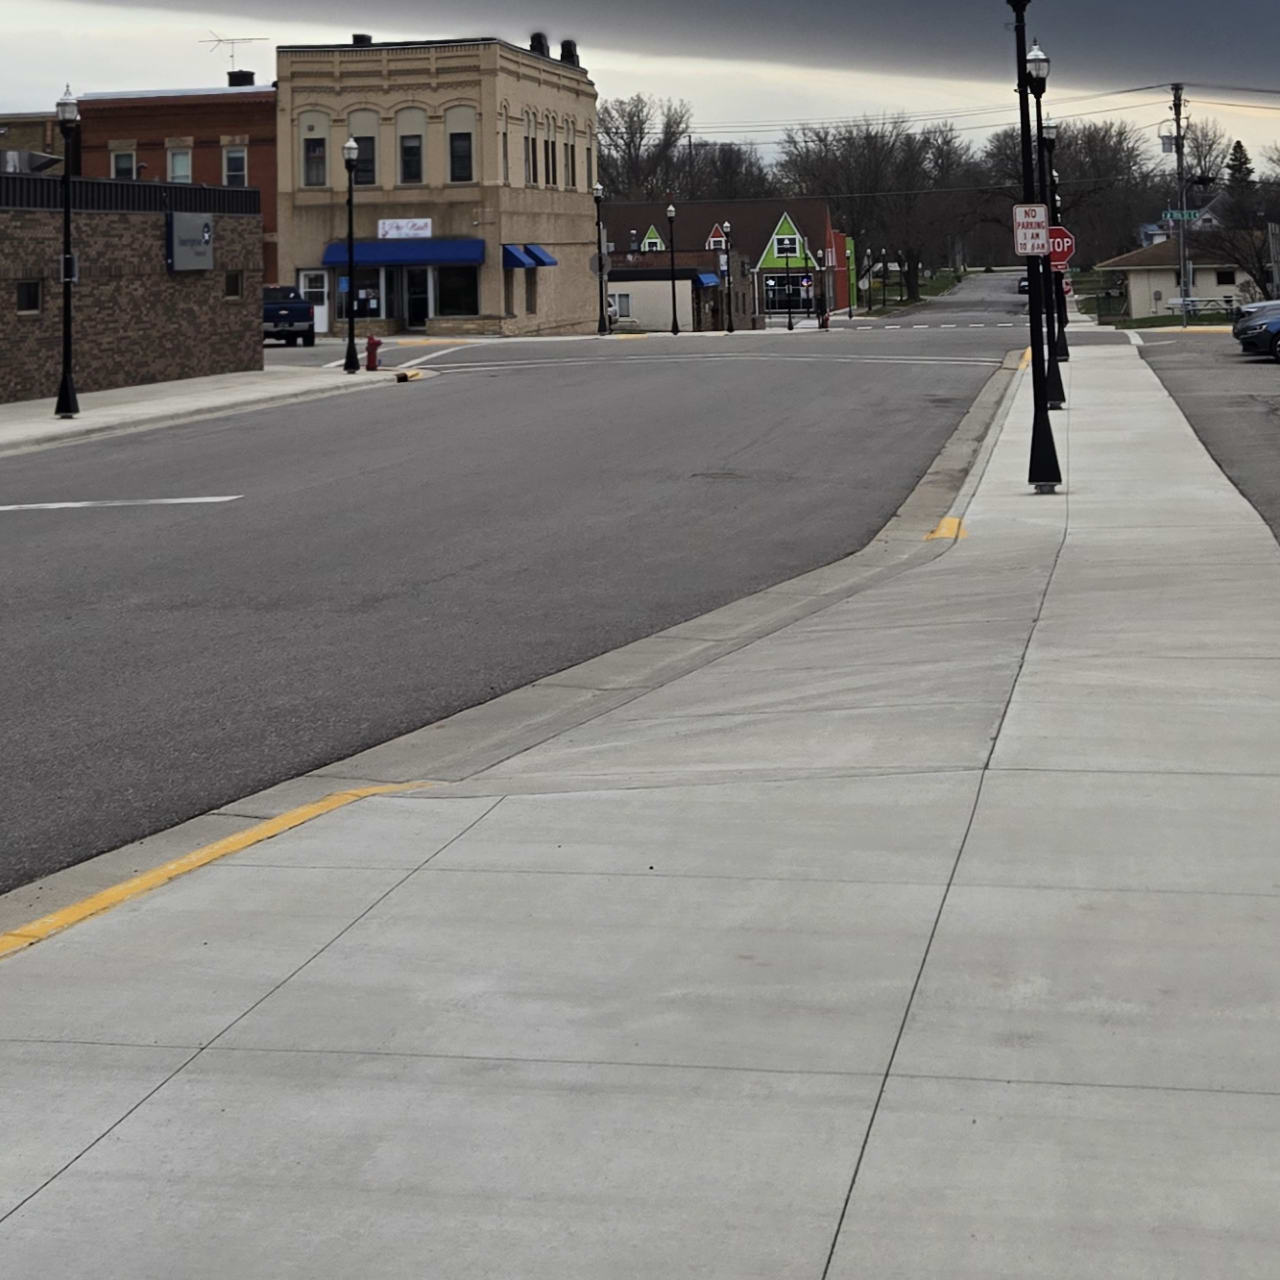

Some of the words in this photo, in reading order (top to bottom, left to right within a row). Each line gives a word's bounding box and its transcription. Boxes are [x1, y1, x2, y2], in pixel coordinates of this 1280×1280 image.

[1024, 208, 1037, 218] NO
[1016, 221, 1046, 230] PARKING
[1031, 232, 1040, 240] AM
[1049, 237, 1072, 252] TOP
